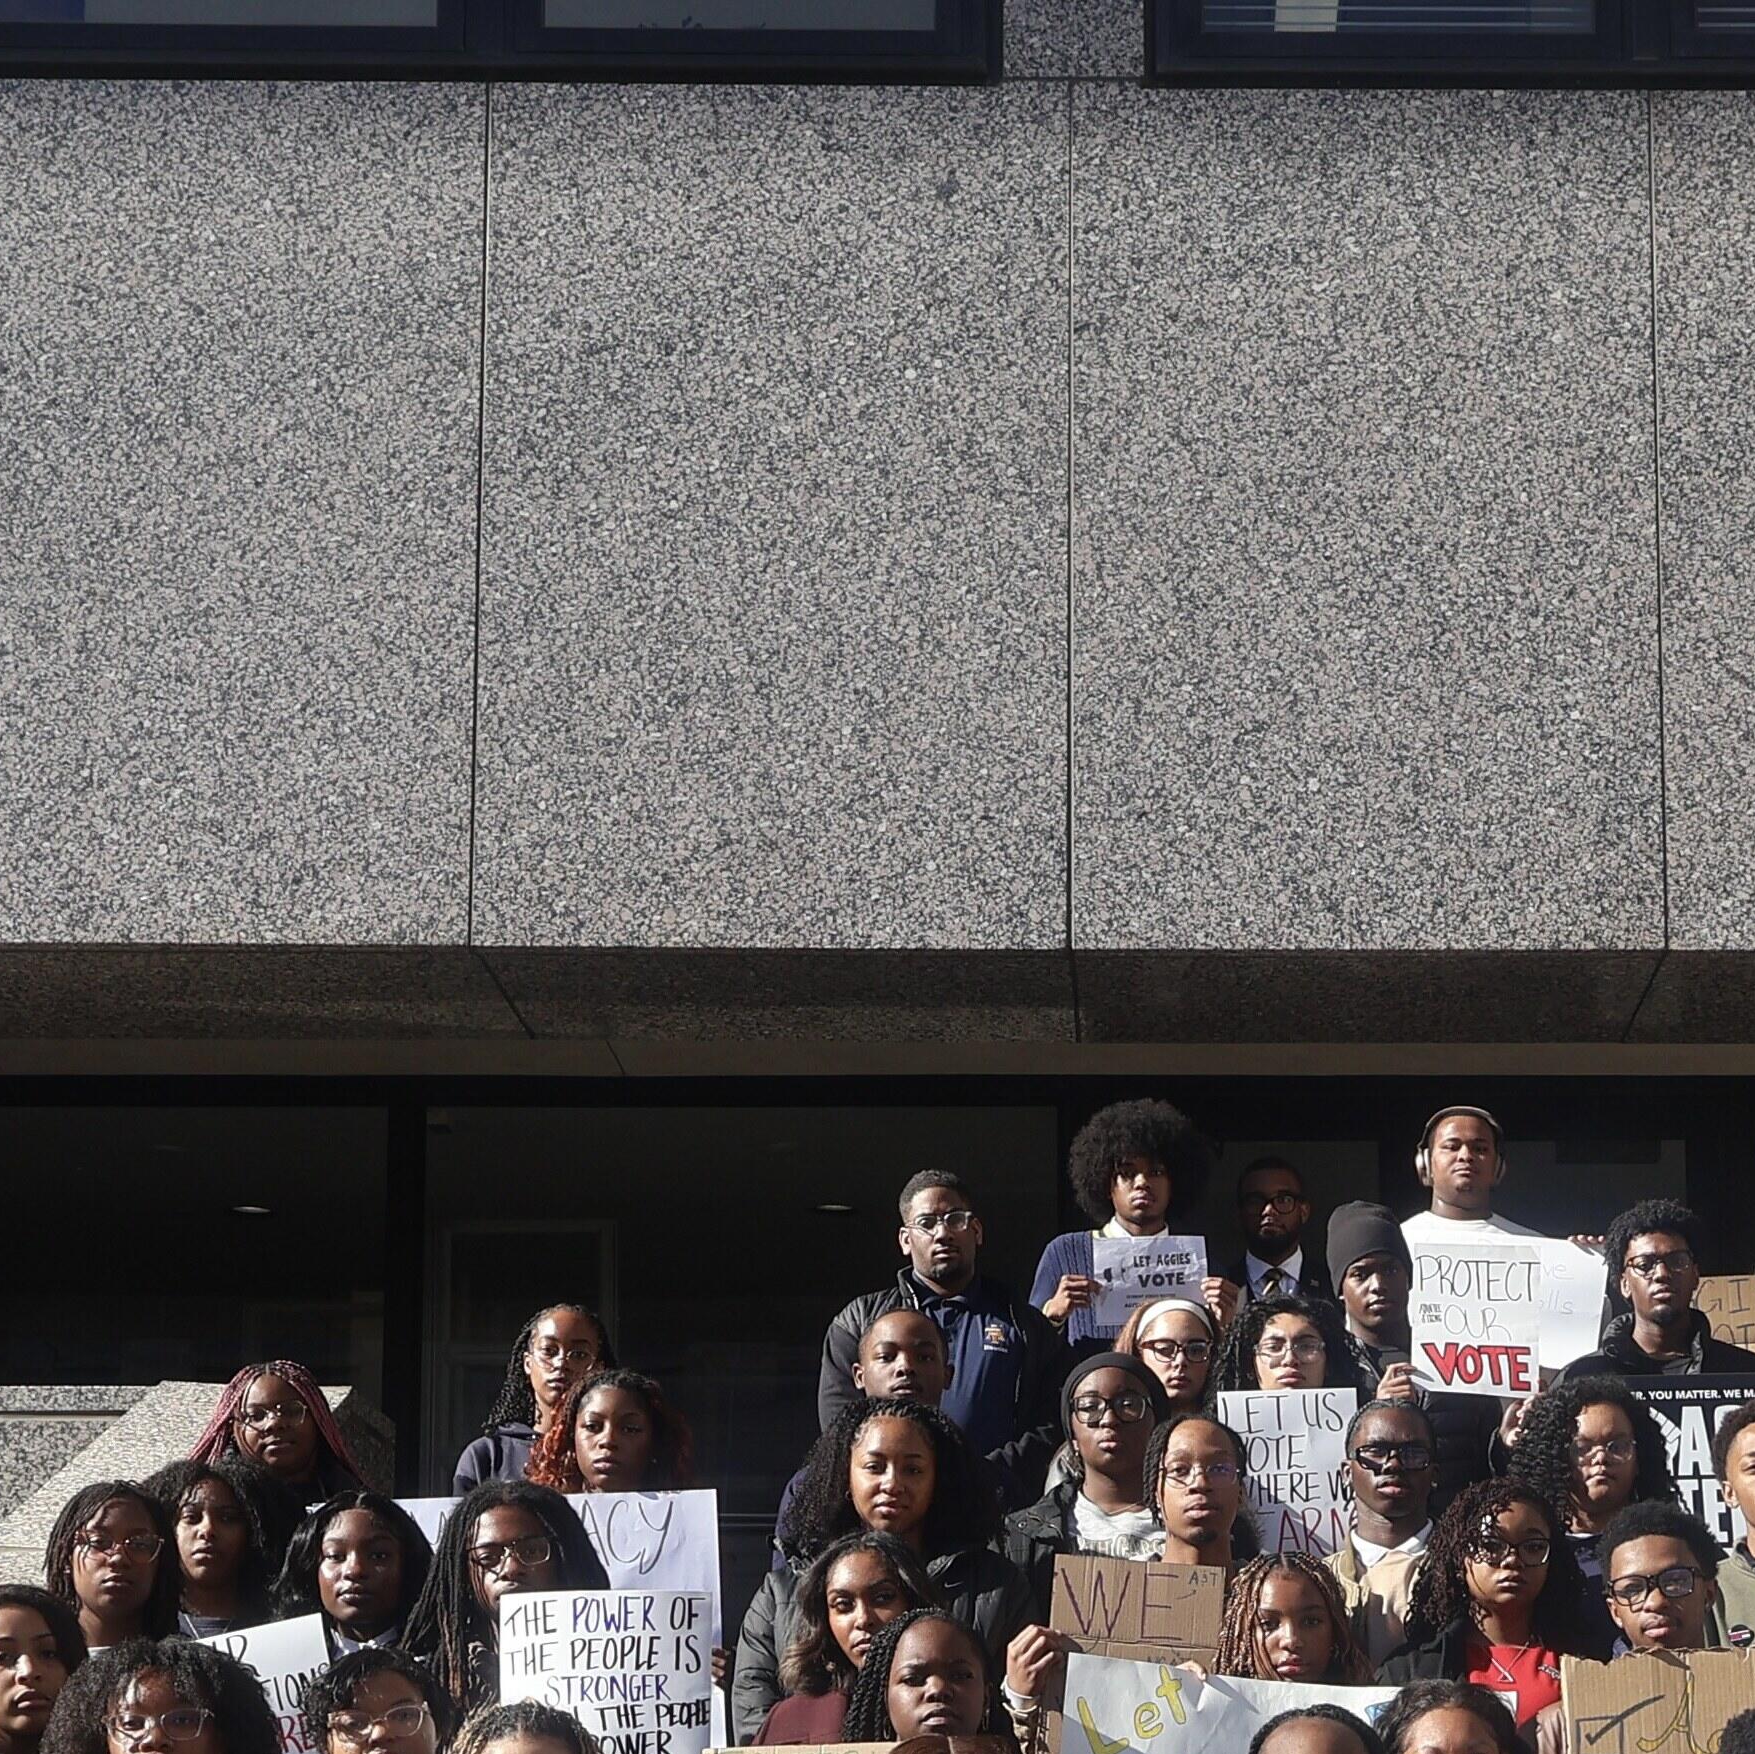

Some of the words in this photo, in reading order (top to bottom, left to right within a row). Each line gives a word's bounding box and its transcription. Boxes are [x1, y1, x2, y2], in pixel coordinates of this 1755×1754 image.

[1133, 1255, 1151, 1268] LET
[1156, 1252, 1191, 1267] AGGIES
[1415, 1255, 1540, 1302] PROTECT
[1138, 1271, 1186, 1288] VOTE
[1444, 1304, 1512, 1341] OUR
[1420, 1342, 1532, 1392] VOTE
[1222, 1394, 1289, 1434] LET
[1302, 1392, 1344, 1432] US
[1648, 1390, 1673, 1400] YOU
[1675, 1389, 1721, 1400] MATTER.
[1723, 1389, 1742, 1399] WE
[1244, 1435, 1307, 1473] OTE
[504, 1599, 559, 1638] THE
[572, 1595, 657, 1634] POWER
[669, 1596, 707, 1631] OF
[1061, 1567, 1183, 1640] WE
[504, 1640, 559, 1677] THE
[570, 1635, 662, 1671] PEOPLE
[675, 1634, 702, 1674] IS
[544, 1673, 672, 1706] STRONGER
[593, 1703, 646, 1732] THE
